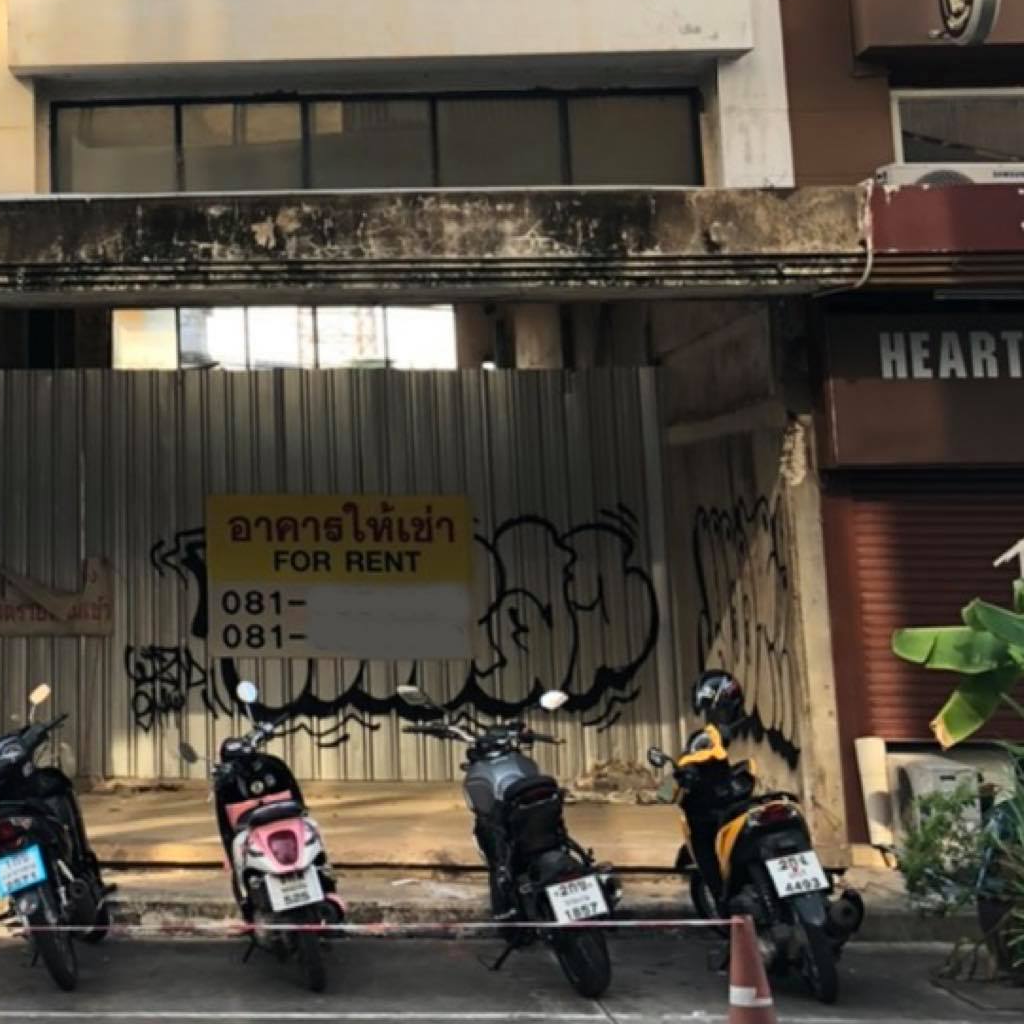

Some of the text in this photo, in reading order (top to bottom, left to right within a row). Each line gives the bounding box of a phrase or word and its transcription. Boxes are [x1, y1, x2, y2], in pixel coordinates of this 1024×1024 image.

[879, 331, 1023, 379] HEART
[227, 501, 456, 543] อาคารให้เช่า
[273, 550, 422, 572] FOR RENT
[221, 590, 307, 616] 081-
[222, 624, 308, 650] 081-
